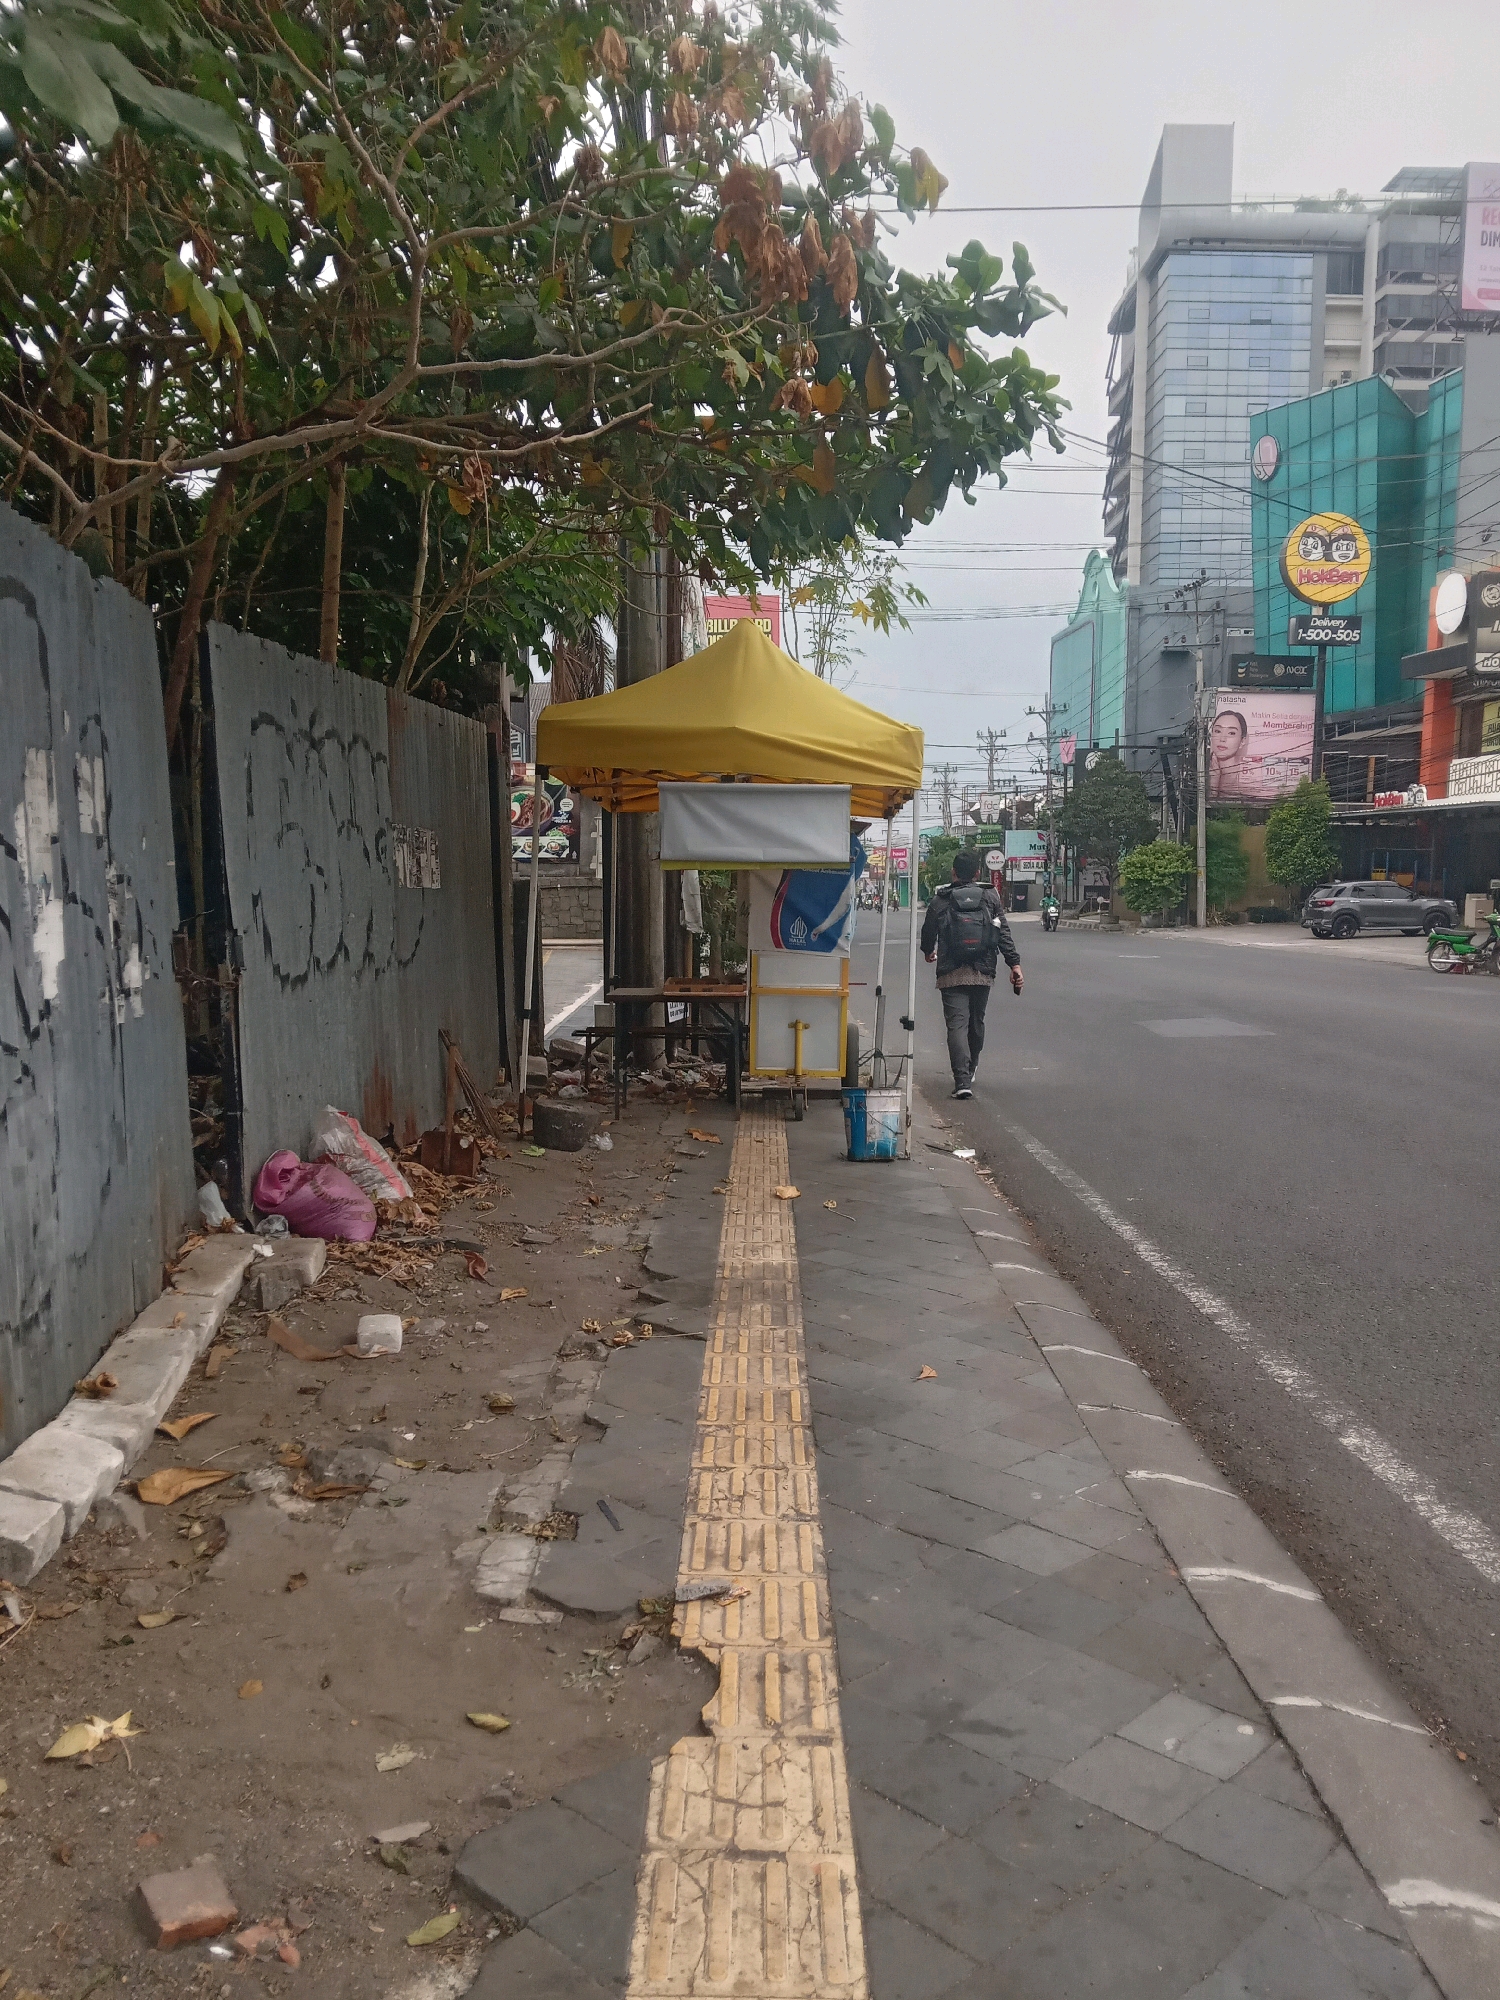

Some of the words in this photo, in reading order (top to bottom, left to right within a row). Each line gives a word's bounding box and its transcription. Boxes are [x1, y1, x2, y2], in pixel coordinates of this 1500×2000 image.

[1298, 567, 1361, 585] HokBen
[1311, 617, 1347, 628] Delivery
[1298, 628, 1360, 641] 1-500-505
[1217, 695, 1247, 704] natasha
[1262, 721, 1313, 732] Membership
